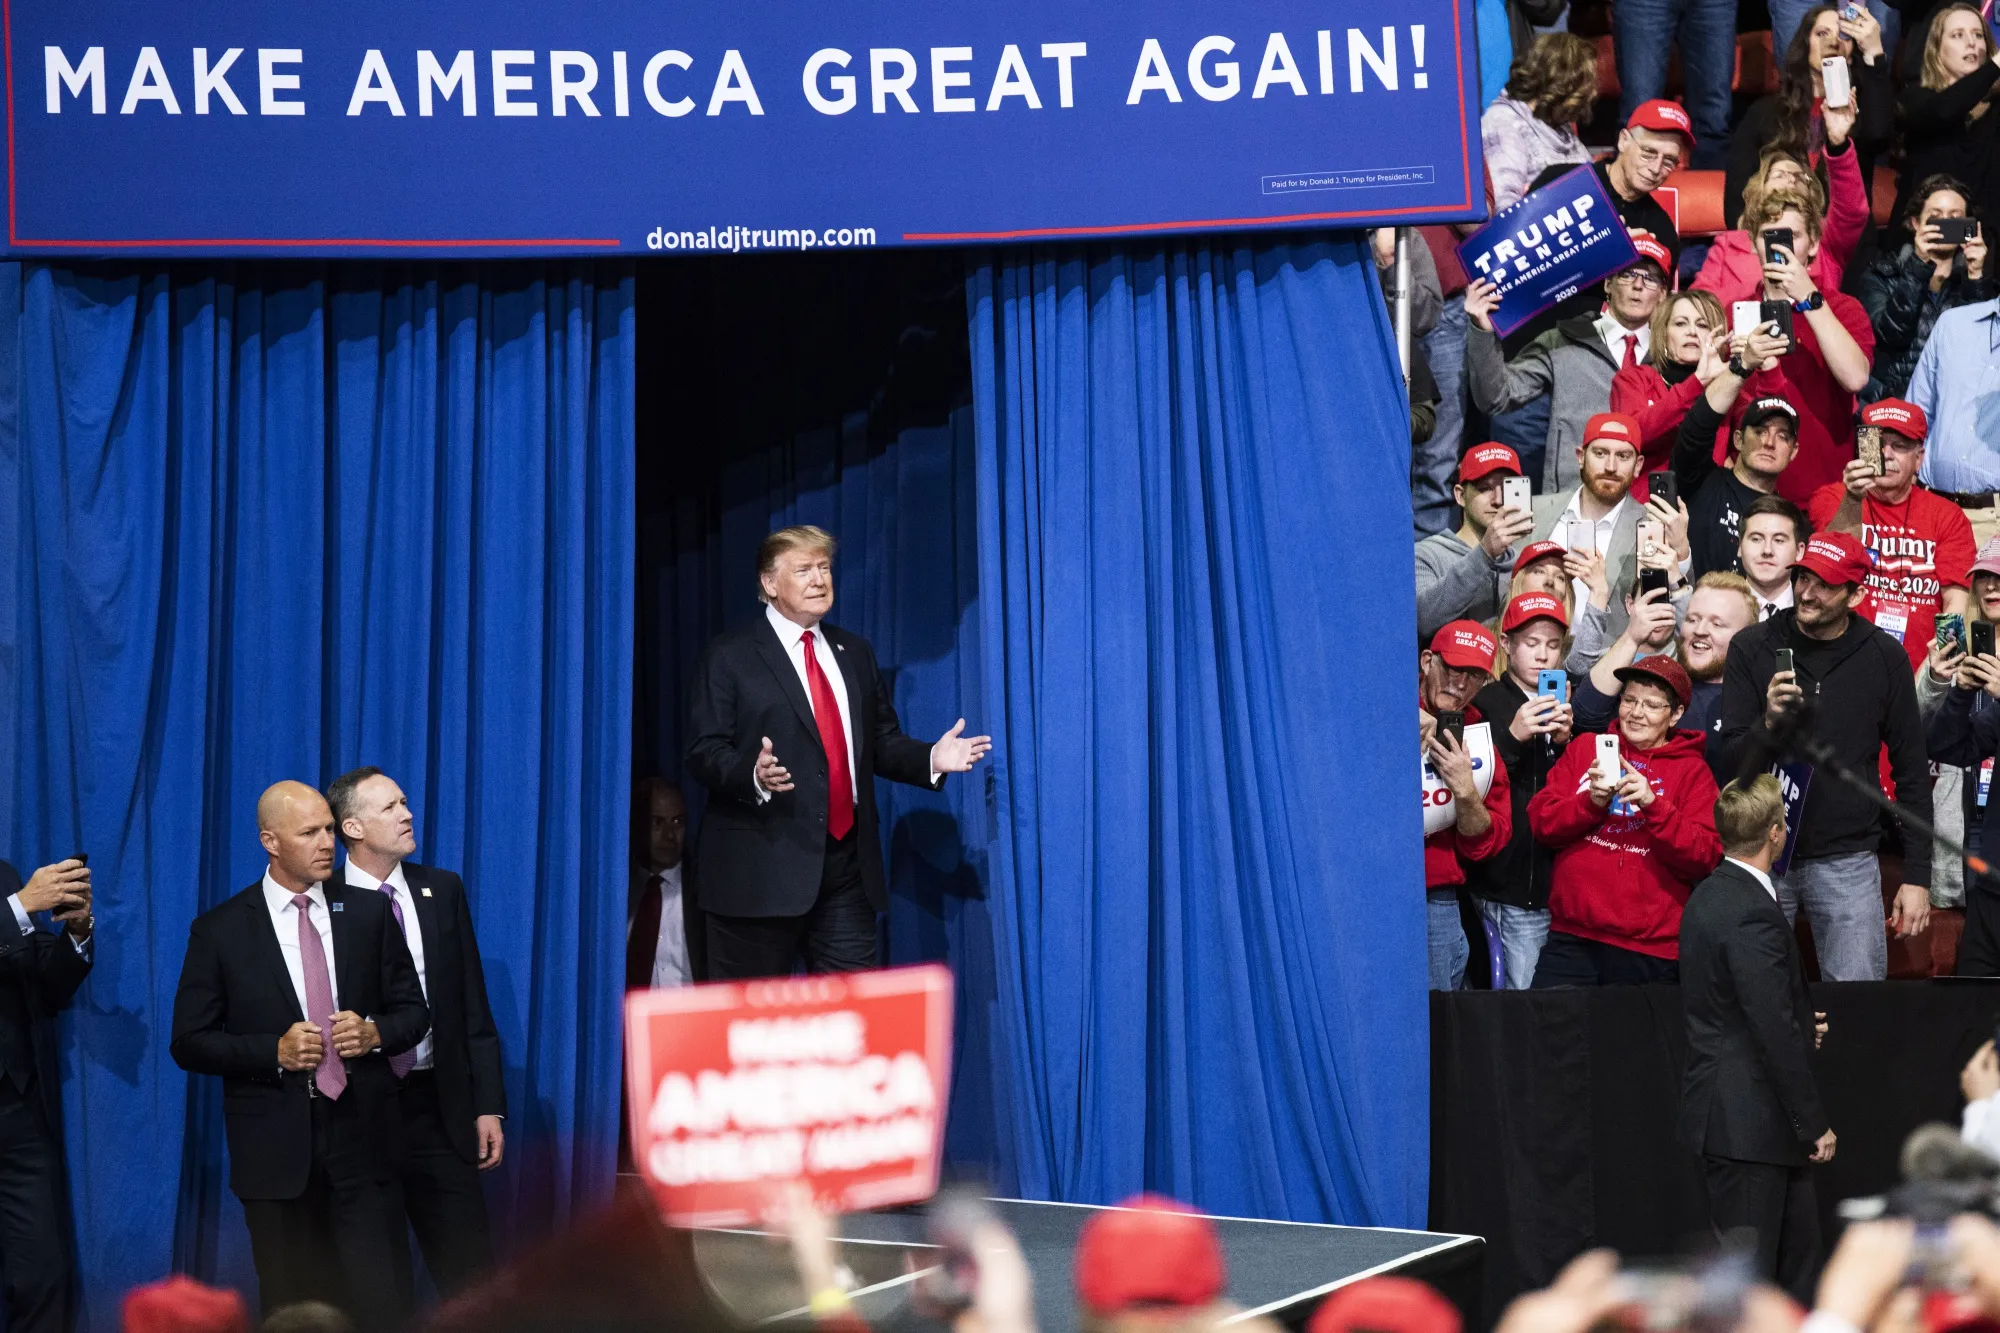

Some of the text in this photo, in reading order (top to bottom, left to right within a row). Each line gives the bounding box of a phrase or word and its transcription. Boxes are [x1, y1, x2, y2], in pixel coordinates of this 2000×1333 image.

[43, 24, 1429, 118] MAKE AMERICA GREAT AGAIN!
[1299, 180, 1308, 188] by
[1309, 177, 1334, 185] Donald
[1342, 176, 1365, 185] Trump
[646, 226, 877, 252] donaldjtrump.com
[1474, 194, 1594, 274] TRUMP
[1492, 219, 1595, 284] PENCE
[1514, 260, 1552, 286] AMERICA
[1552, 245, 1580, 264] GREAT
[1581, 227, 1612, 249] AGAIN!
[1554, 285, 1578, 302] 2020
[1757, 398, 1797, 416] TRUMP
[1474, 449, 1490, 459] MAKE
[1861, 522, 1936, 566] Trump
[1901, 576, 1940, 596] 2020
[1519, 597, 1557, 607] MAKE AMERICA
[1872, 590, 1908, 602] AMERICA
[1911, 596, 1936, 605] GREAT
[1522, 603, 1539, 612] GREAT
[1454, 630, 1473, 639] MAKE
[1455, 638, 1478, 648] GREAT
